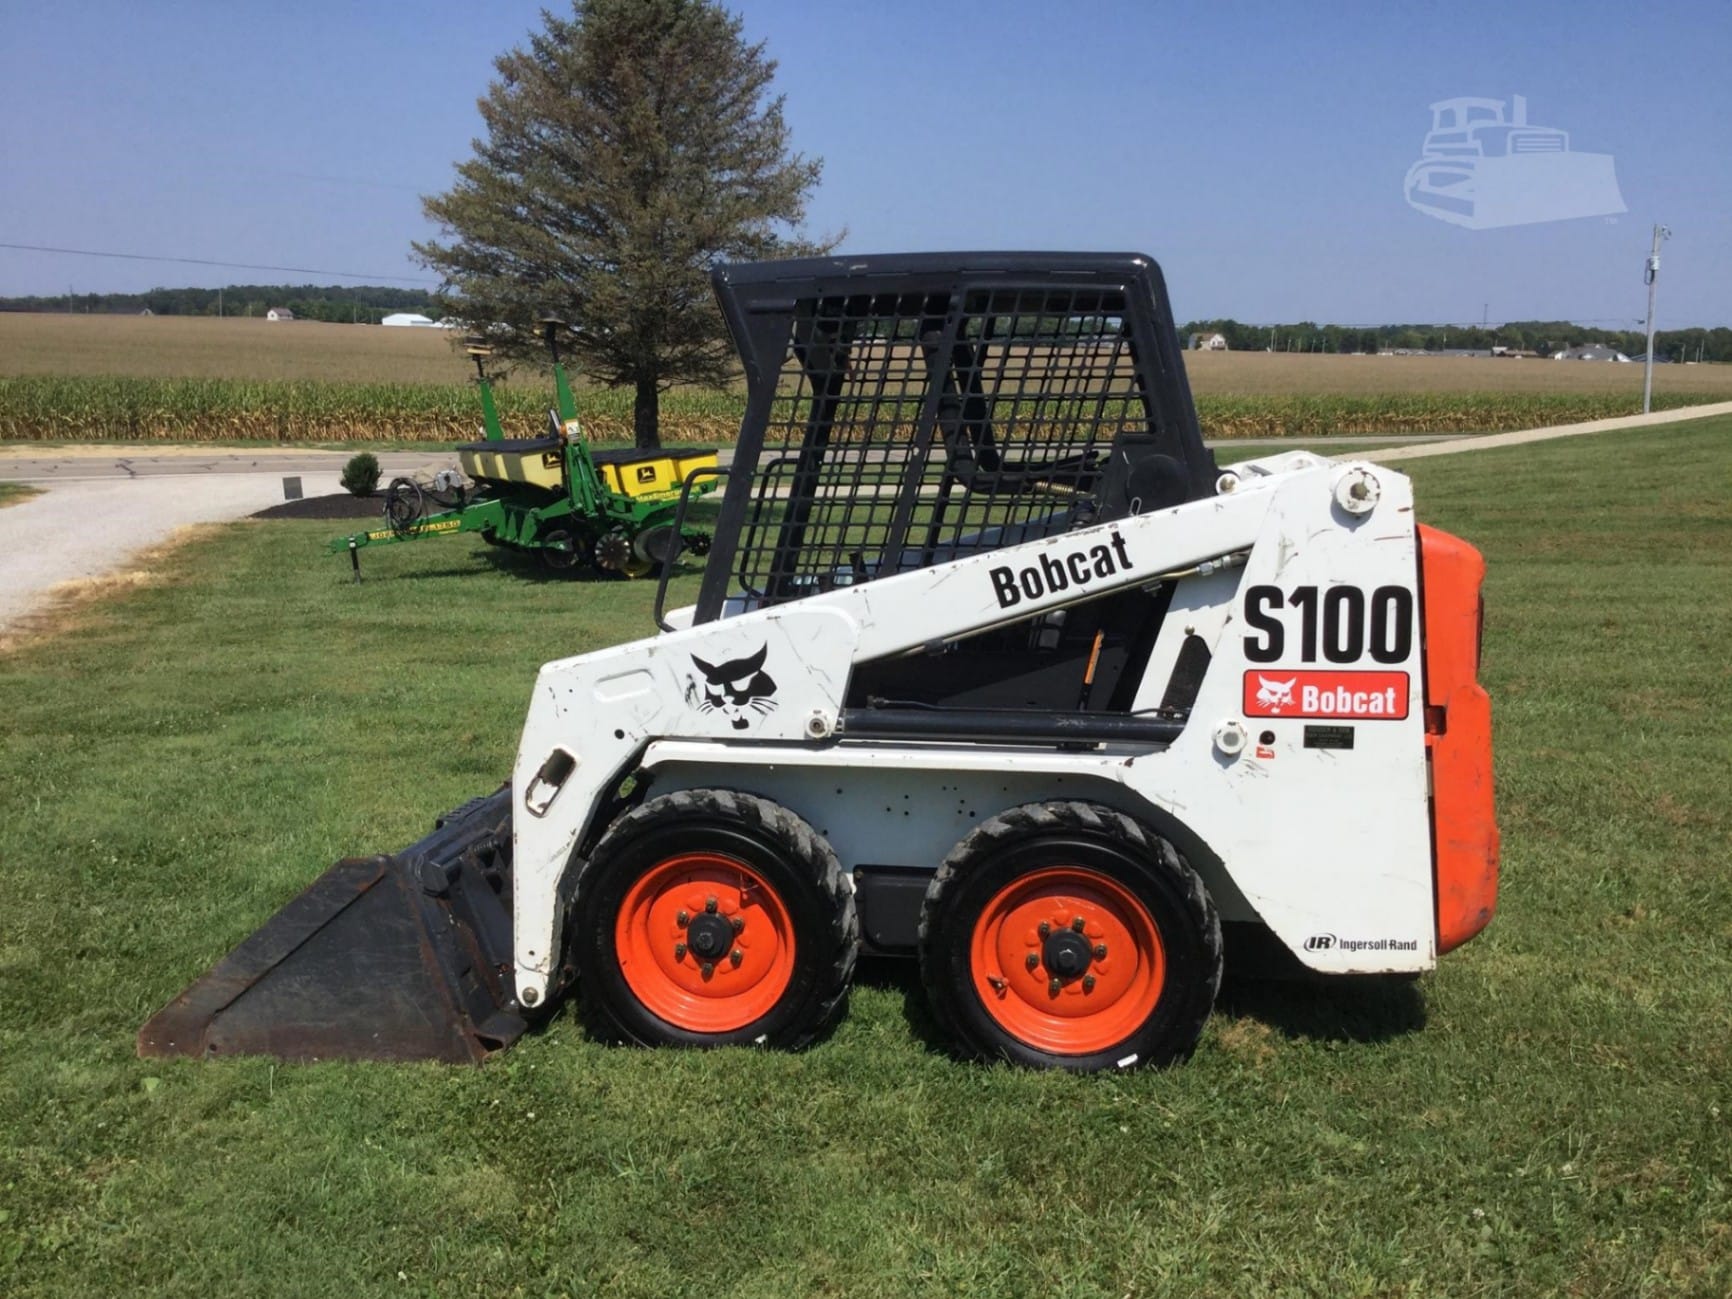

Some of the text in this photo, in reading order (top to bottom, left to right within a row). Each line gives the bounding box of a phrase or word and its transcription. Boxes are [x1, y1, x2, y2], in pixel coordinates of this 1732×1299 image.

[989, 531, 1133, 609] Bobcat
[1243, 585, 1413, 664] S100
[1302, 685, 1396, 714] Bobcat
